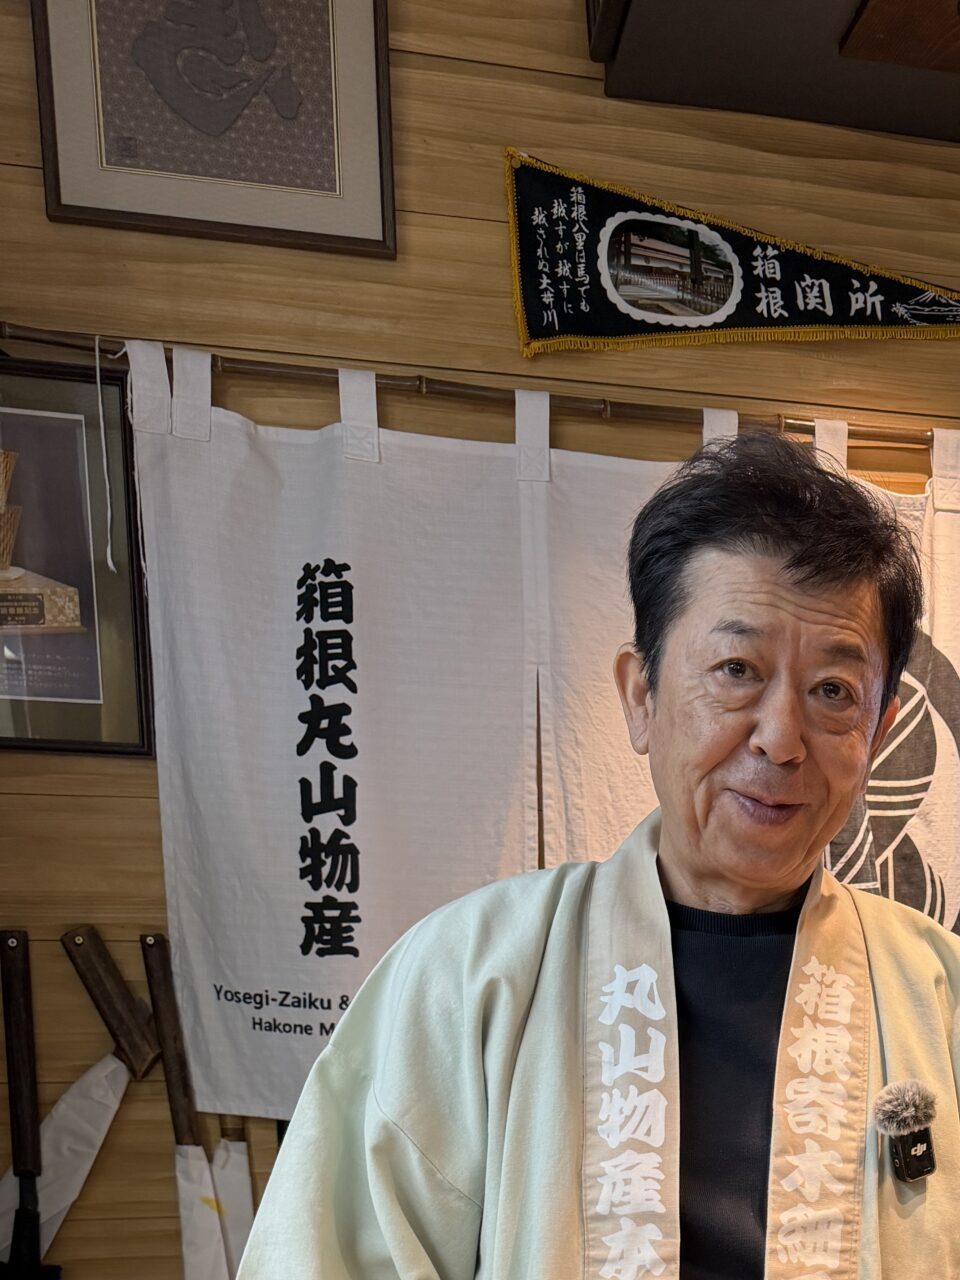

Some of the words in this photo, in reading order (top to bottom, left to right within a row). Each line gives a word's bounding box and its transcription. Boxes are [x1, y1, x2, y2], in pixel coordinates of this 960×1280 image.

[296, 558, 362, 958] 箱根丸山物産
[213, 984, 332, 1010] Yosegi-Zaiku
[252, 1017, 313, 1036] Hakone
